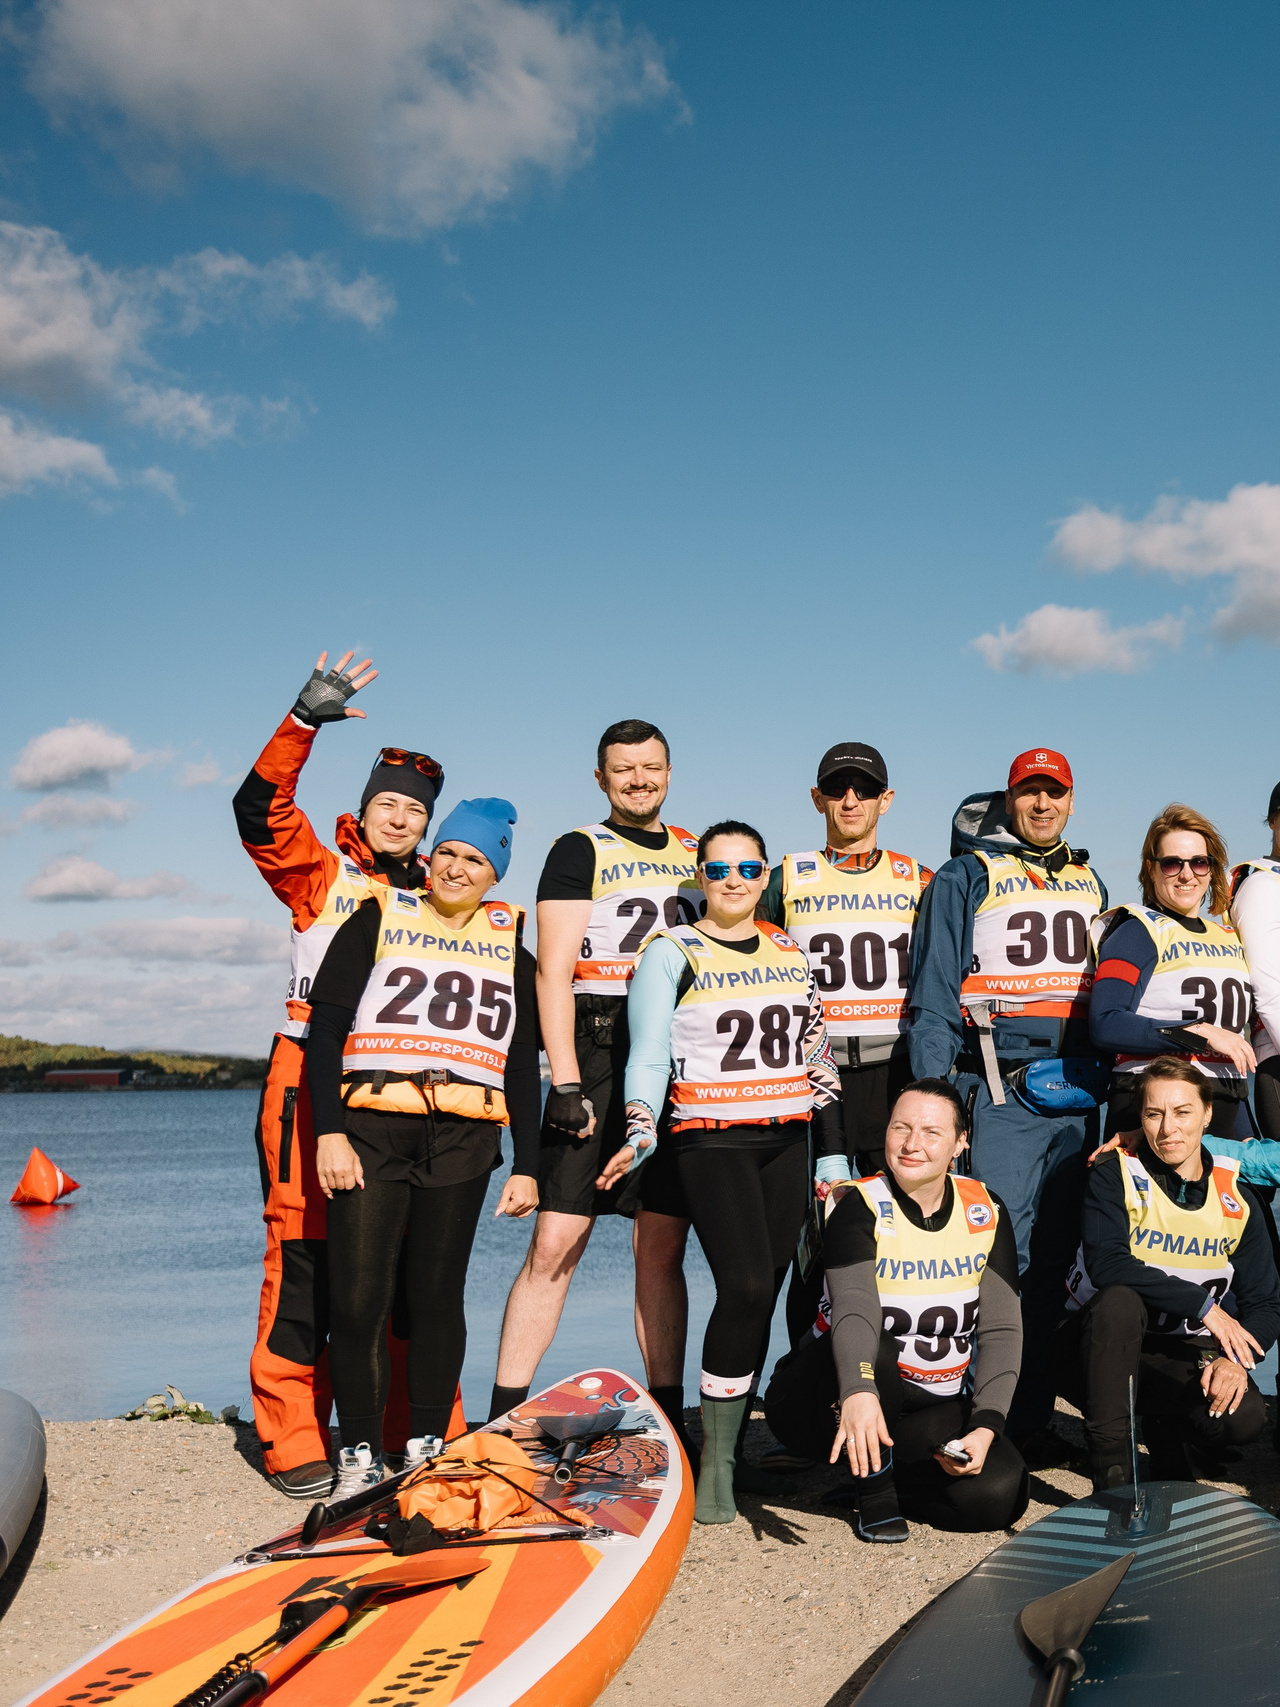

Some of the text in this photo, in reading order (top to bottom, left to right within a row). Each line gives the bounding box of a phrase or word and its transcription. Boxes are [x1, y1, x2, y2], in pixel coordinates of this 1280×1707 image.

[601, 862, 697, 885] МУРМАН
[581, 936, 593, 959] 8
[616, 896, 708, 953] 29
[1006, 909, 1100, 967] 30
[809, 931, 909, 992] 301
[986, 976, 1095, 990] WWW.GORSPO
[376, 966, 513, 1041] 285
[716, 1004, 811, 1072] 287
